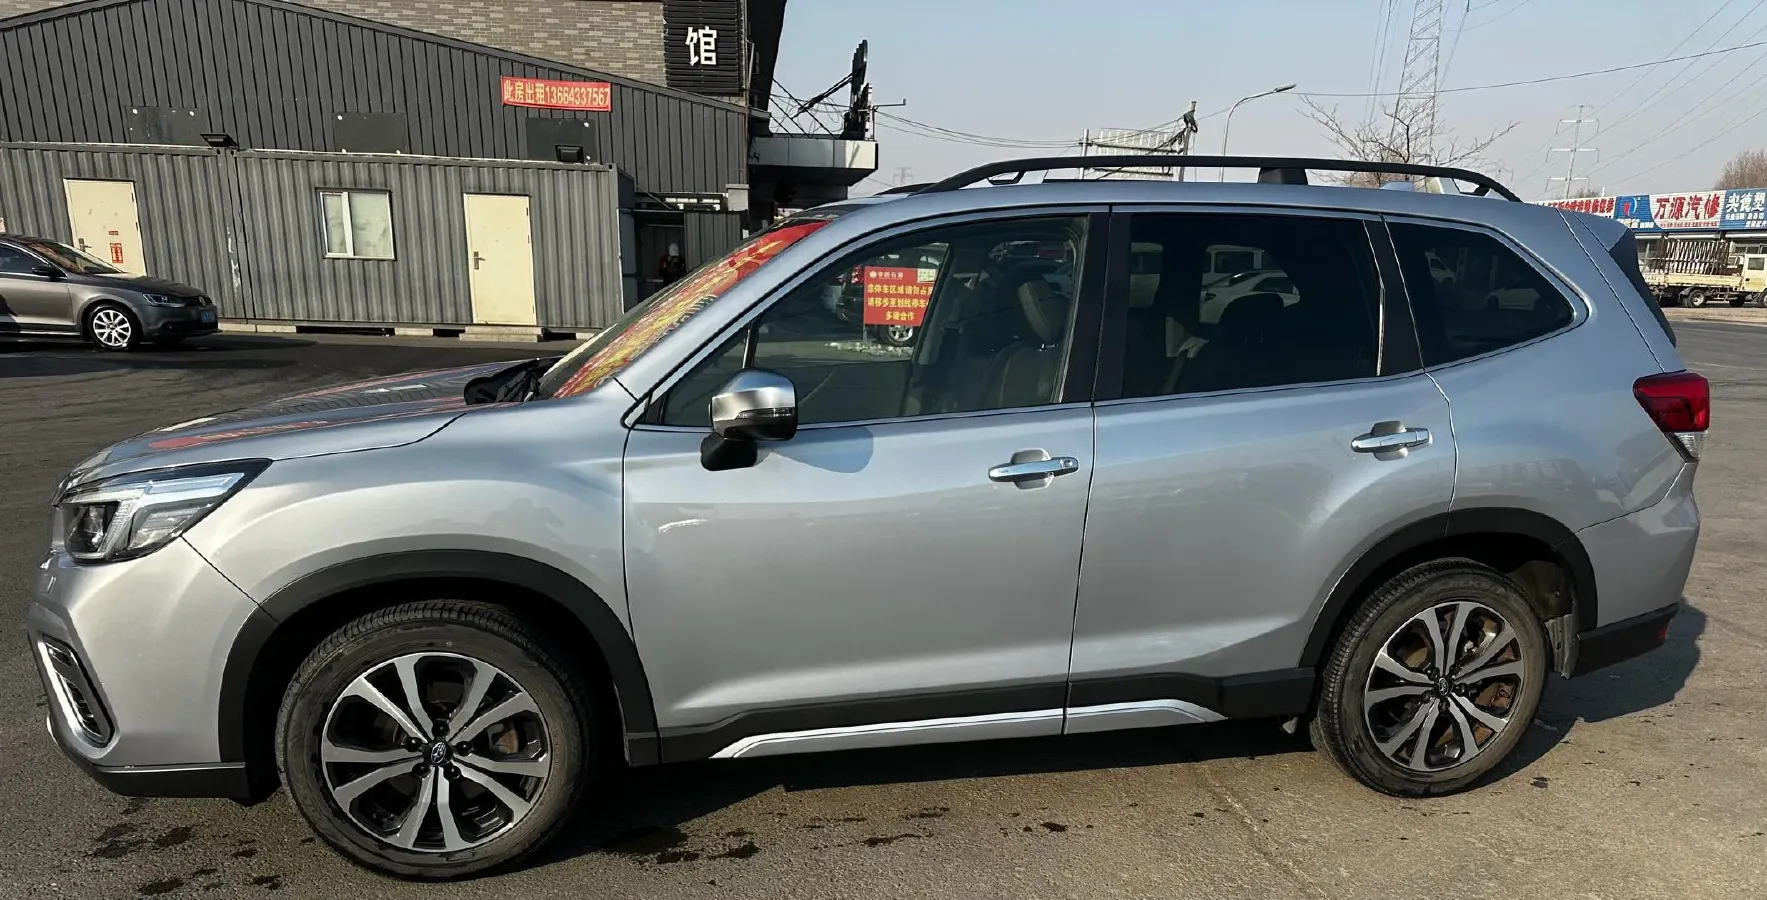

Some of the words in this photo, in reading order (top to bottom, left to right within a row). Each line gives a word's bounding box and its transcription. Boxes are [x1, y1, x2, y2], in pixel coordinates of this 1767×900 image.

[685, 26, 717, 66] 馆
[503, 80, 610, 105] 此房出租13664337567
[1654, 193, 1721, 220] 万源汽修
